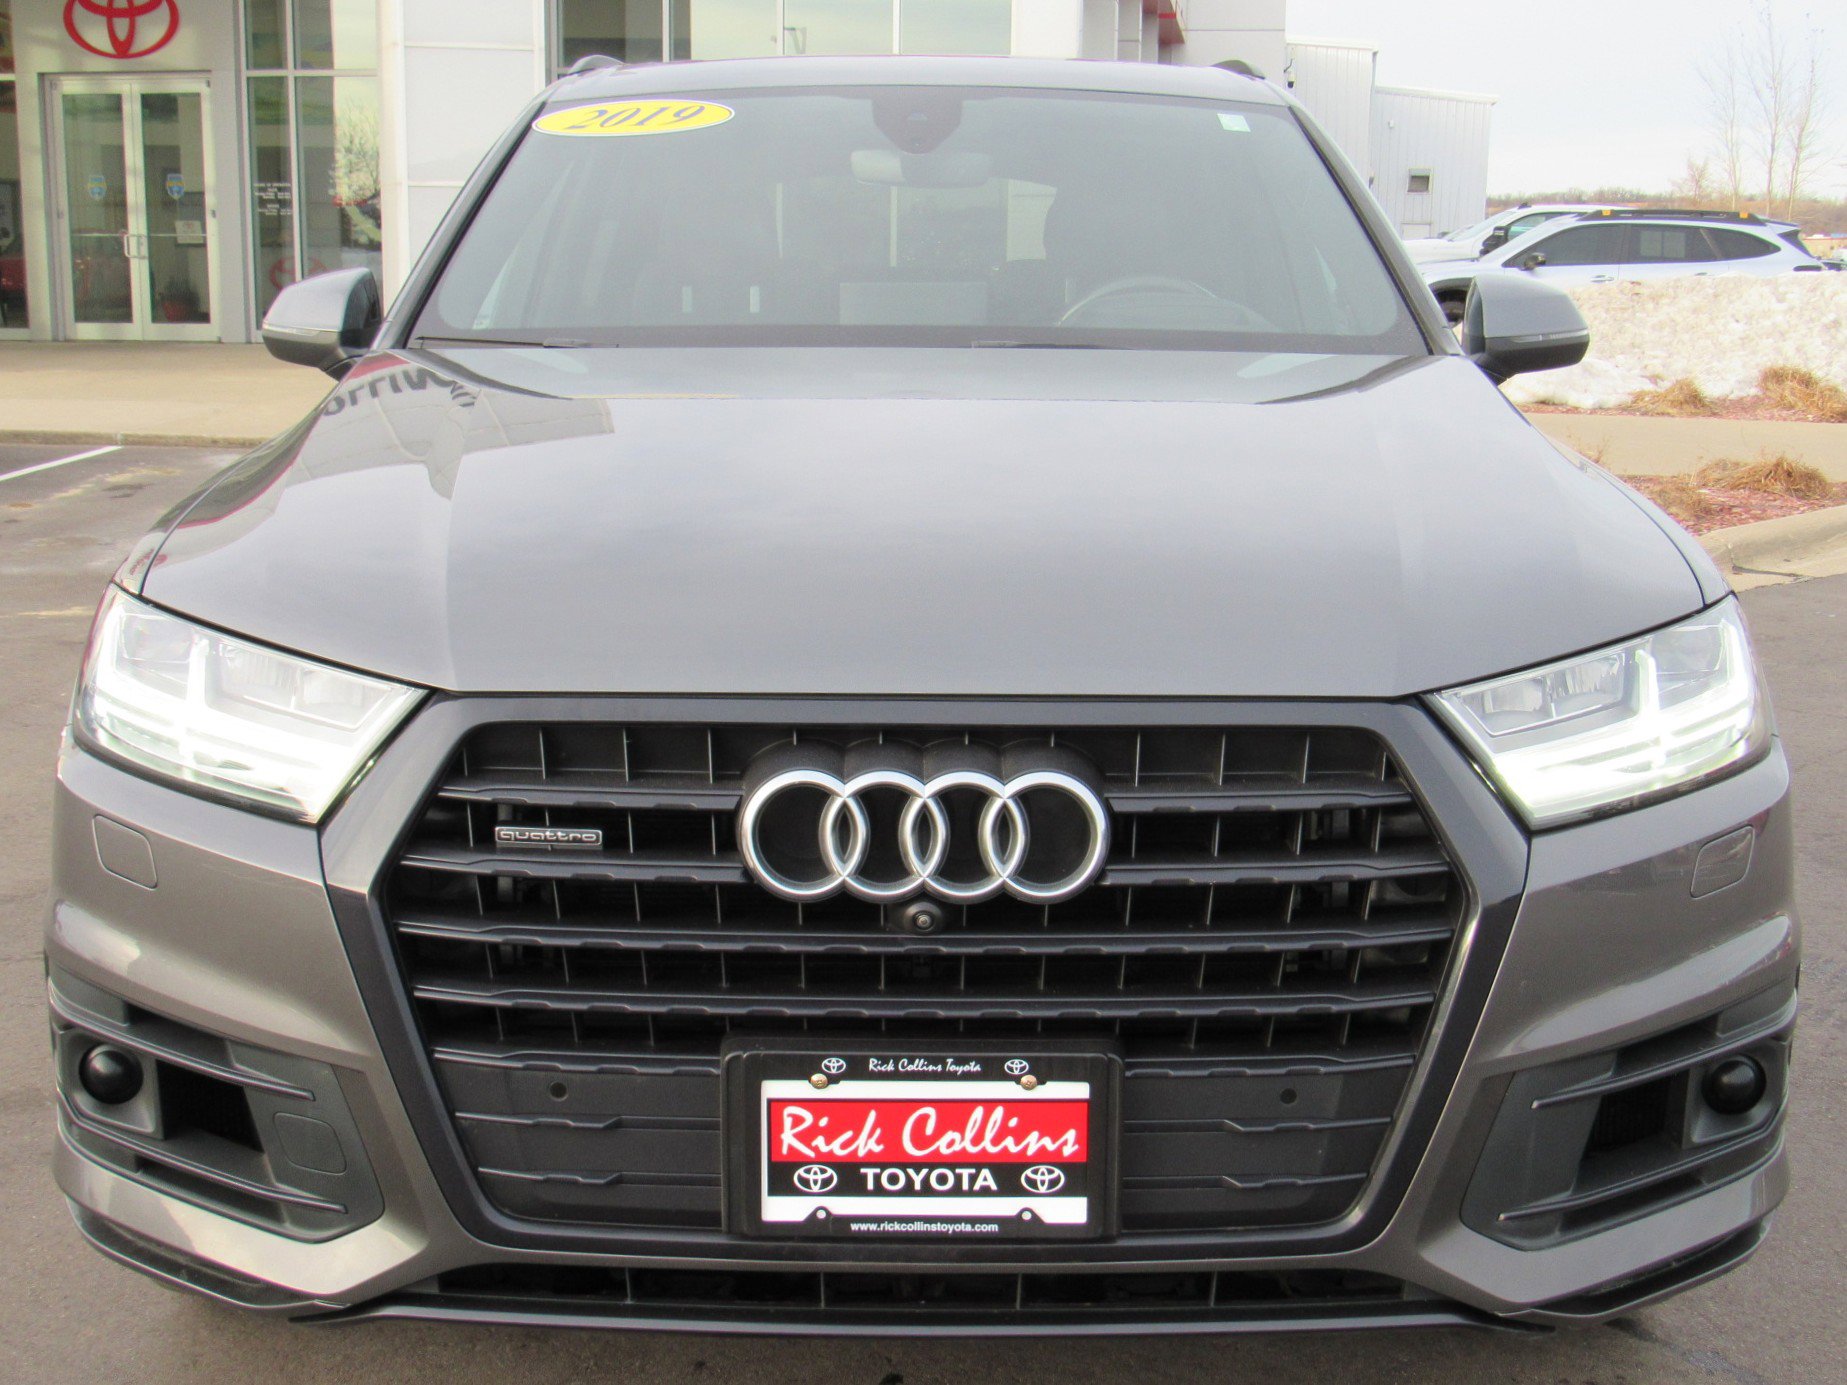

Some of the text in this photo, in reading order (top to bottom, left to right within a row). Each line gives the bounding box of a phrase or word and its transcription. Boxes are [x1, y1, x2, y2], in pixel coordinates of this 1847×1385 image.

[564, 105, 705, 129] 2019
[500, 830, 597, 841] quattro
[868, 1057, 982, 1075] Rick Collins Toyota
[780, 1105, 1078, 1158] Rick Collins
[860, 1167, 998, 1191] TOYOTA
[850, 1220, 999, 1233] www.rickcollinstoyota.com
